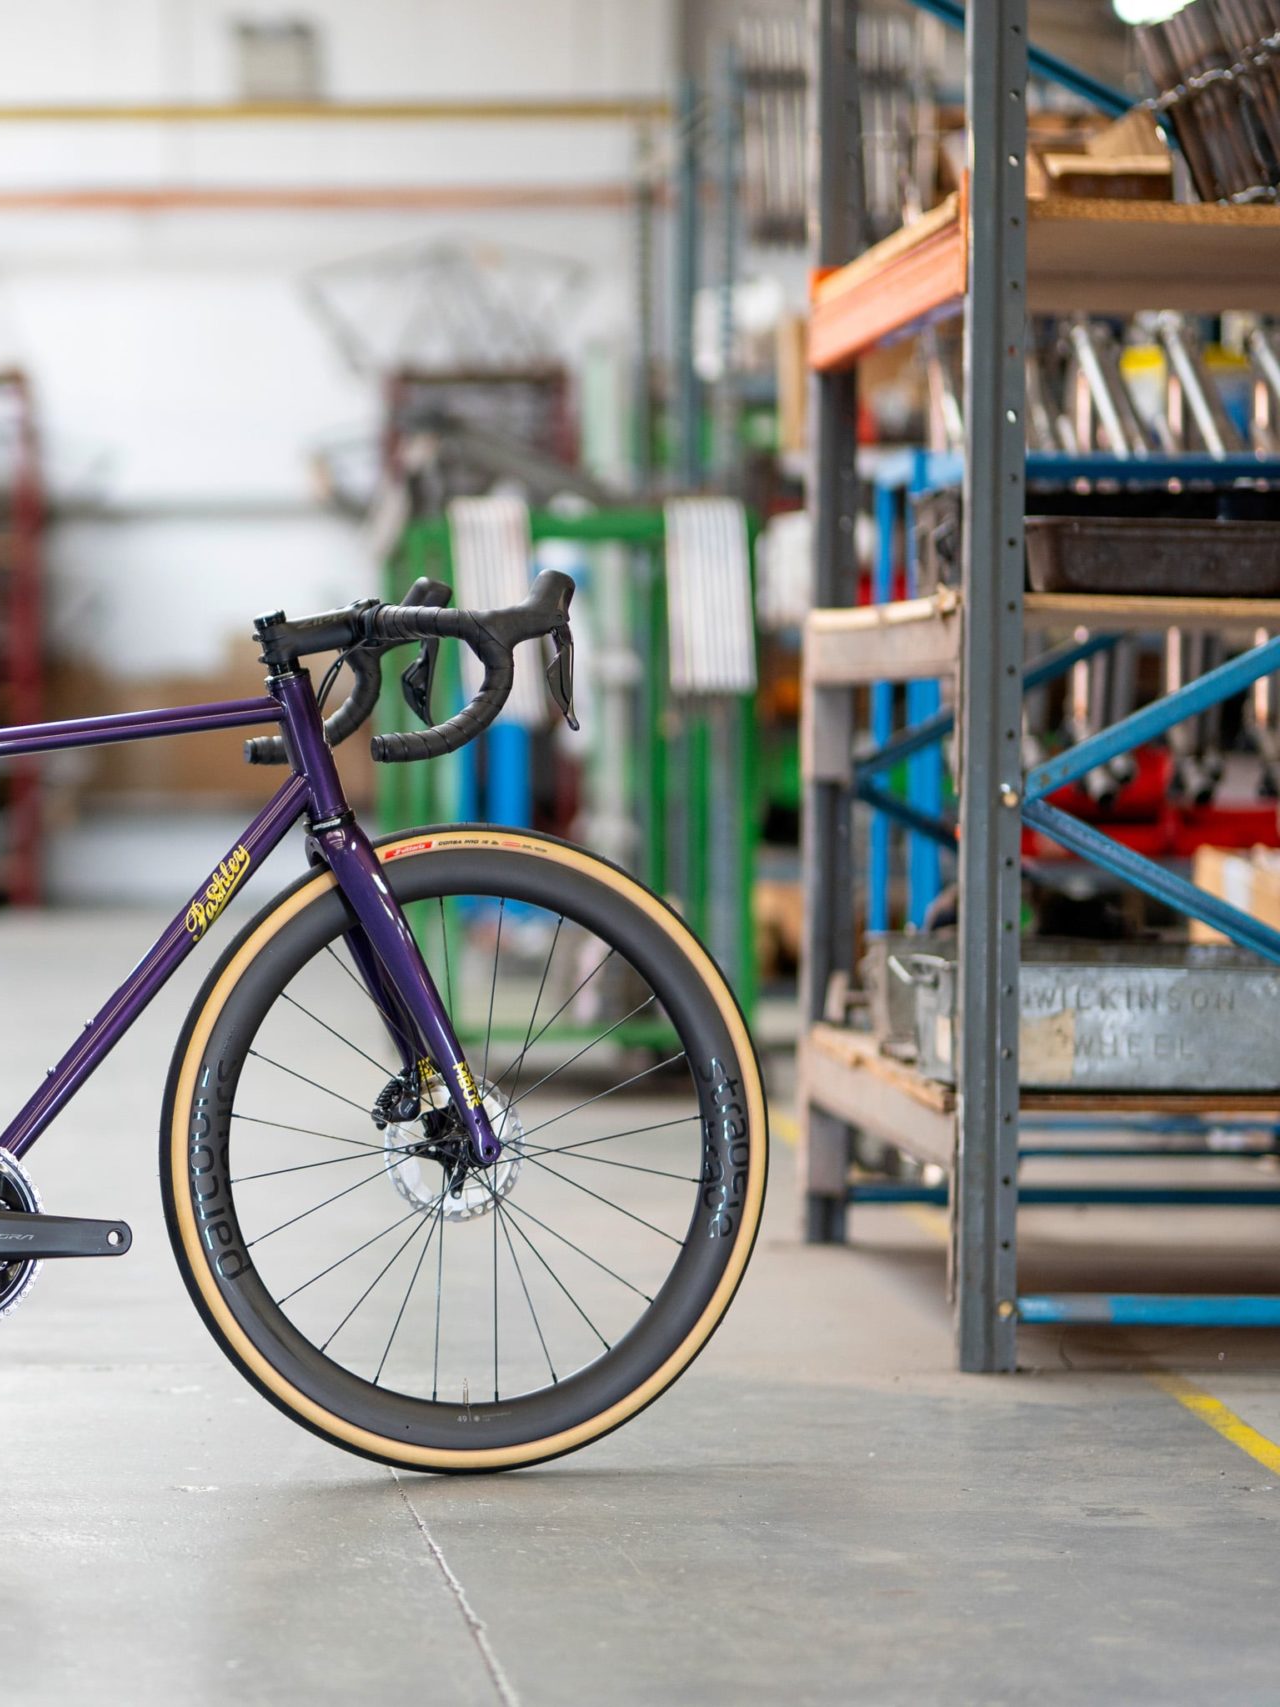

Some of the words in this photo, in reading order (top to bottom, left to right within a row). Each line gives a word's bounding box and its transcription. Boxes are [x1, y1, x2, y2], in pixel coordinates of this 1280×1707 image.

[186, 845, 250, 941] Pashley
[1036, 981, 1236, 1011] WILKINSON
[1074, 1032, 1194, 1059] WHEEL
